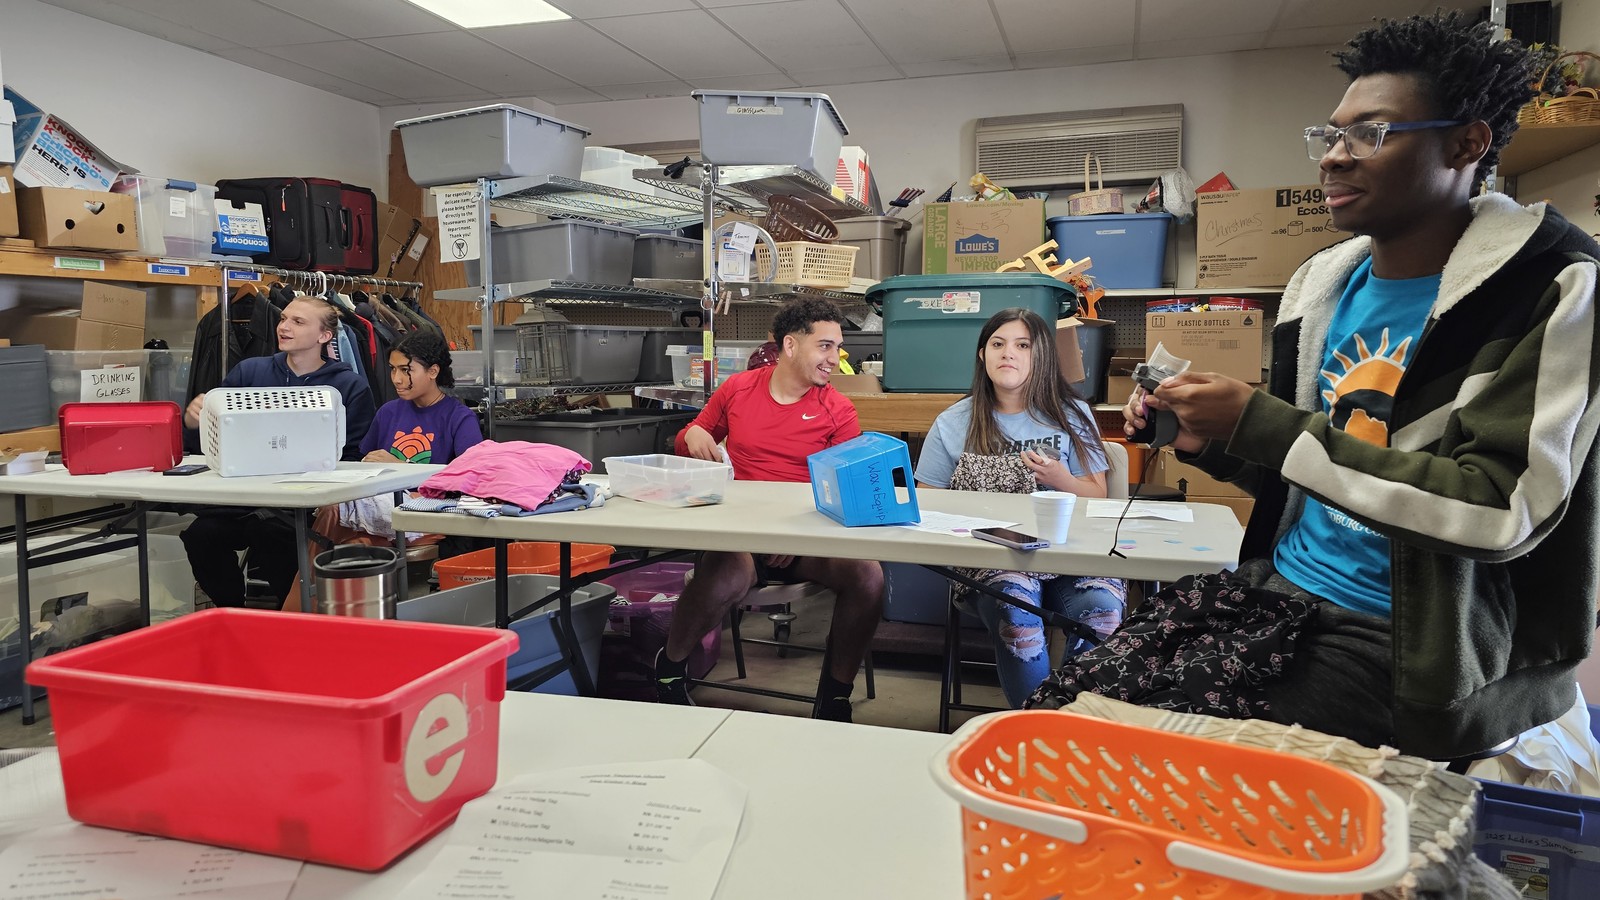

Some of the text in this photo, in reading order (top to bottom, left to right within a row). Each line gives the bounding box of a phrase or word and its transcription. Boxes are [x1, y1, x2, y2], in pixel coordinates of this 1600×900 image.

[47, 118, 97, 161] KNOCK,
[32, 144, 70, 176] HERE.
[36, 137, 72, 166] BEST
[73, 165, 87, 179] IS
[40, 131, 110, 188] CHICAGO'S
[935, 206, 946, 248] LARGE
[1204, 212, 1264, 241] Christmas
[959, 241, 995, 252] LOWE'S
[1203, 319, 1230, 327] BOTTLES
[91, 373, 135, 386] DRINKING
[96, 387, 131, 398] GLASSES
[404, 692, 469, 803] e
[1540, 837, 1585, 855] Summer
